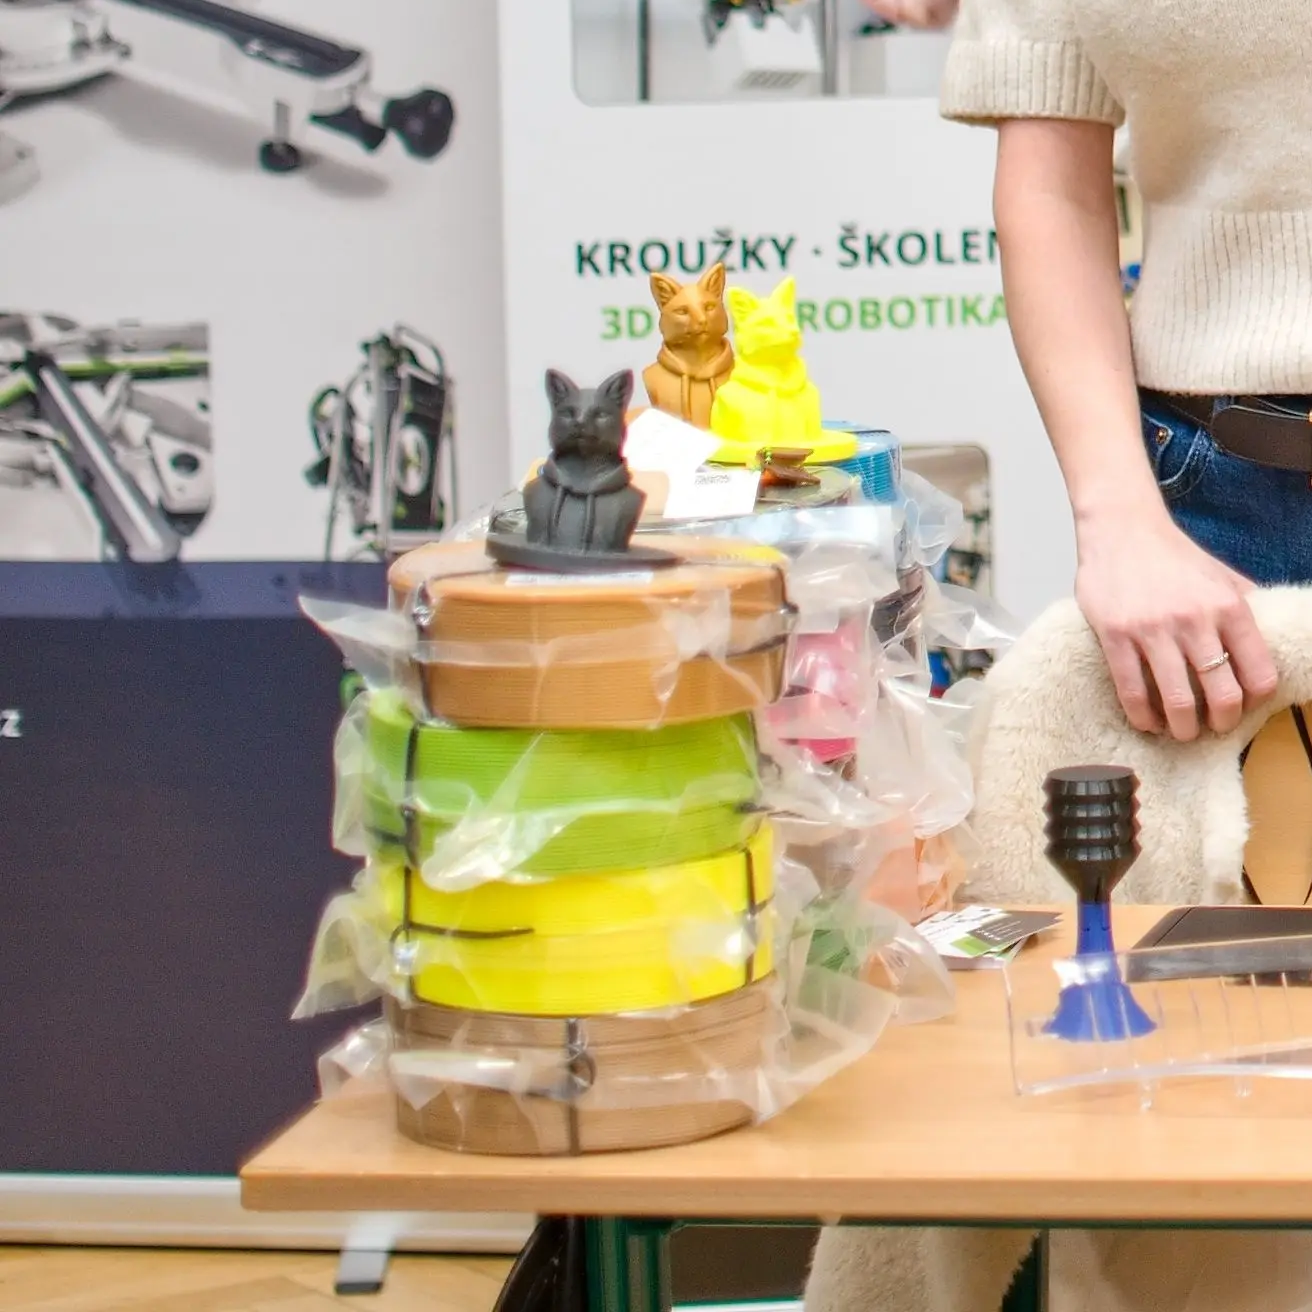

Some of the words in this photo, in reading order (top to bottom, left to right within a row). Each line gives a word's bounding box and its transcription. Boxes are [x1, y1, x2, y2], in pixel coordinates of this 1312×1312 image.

[576, 228, 798, 277] KROUŽKY
[600, 304, 653, 340] 3D
[797, 293, 1008, 333] ROBOTIKA
